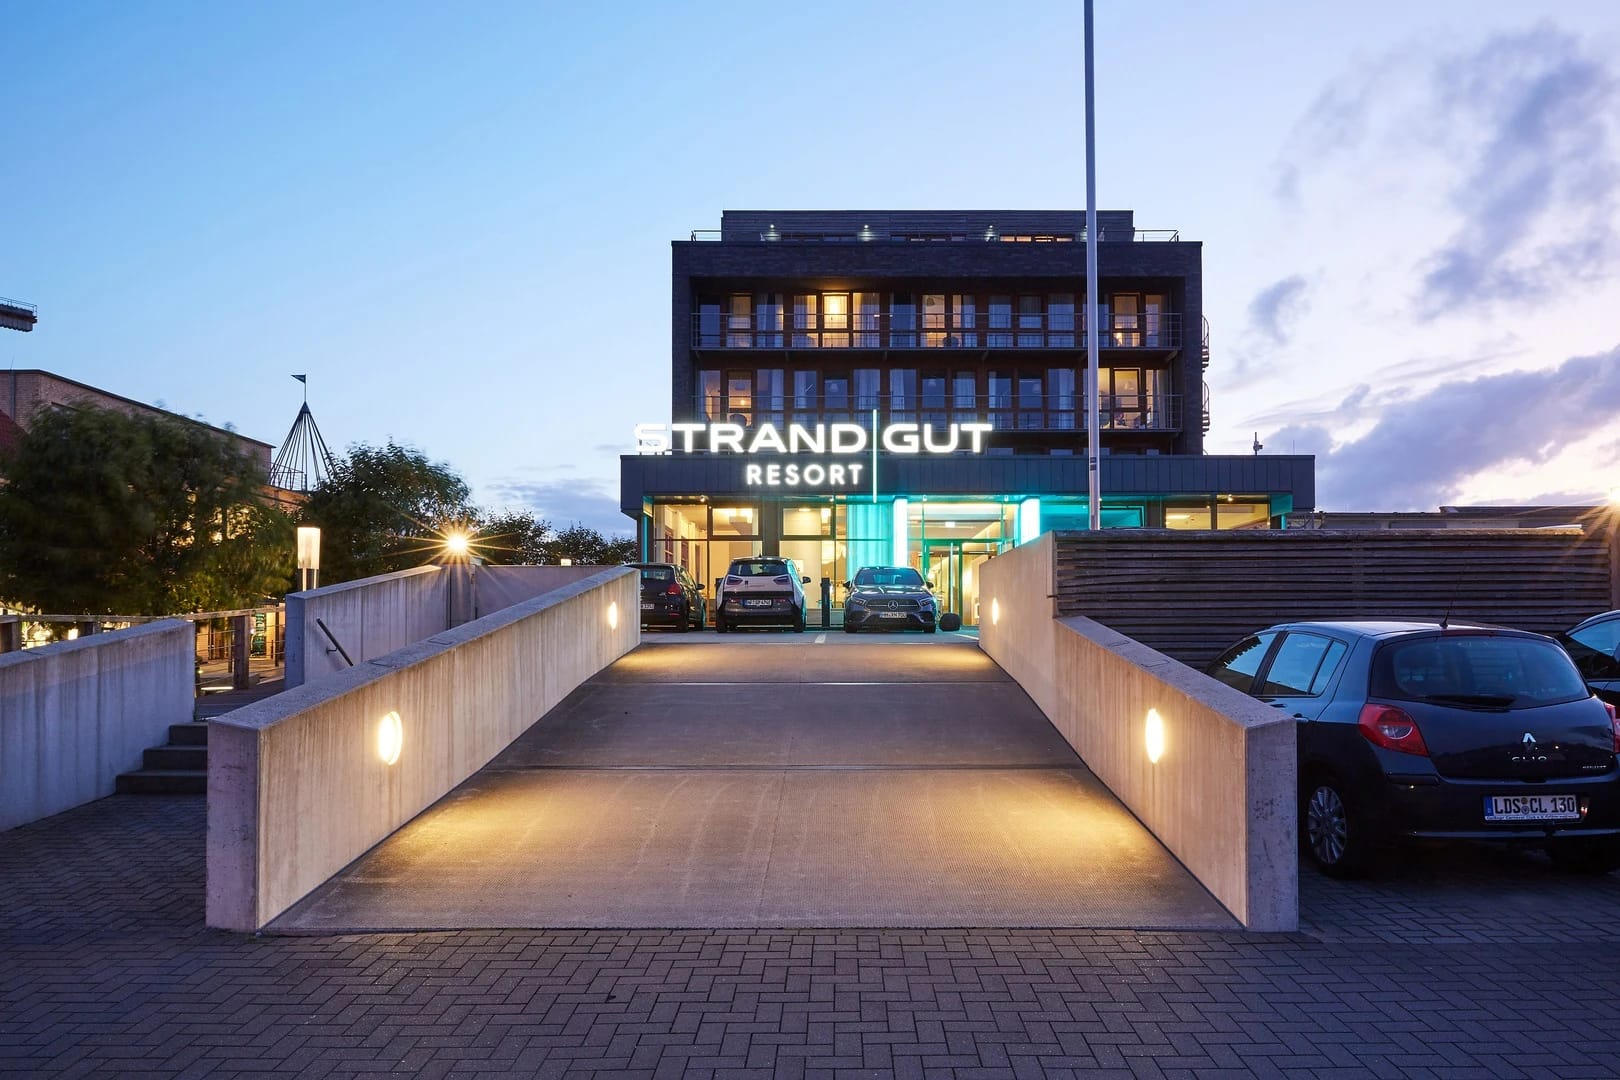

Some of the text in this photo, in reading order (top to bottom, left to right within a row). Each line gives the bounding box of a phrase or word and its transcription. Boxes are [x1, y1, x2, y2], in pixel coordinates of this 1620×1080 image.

[634, 423, 993, 453] STRAND GUT
[746, 464, 863, 485] RESORT
[1494, 797, 1575, 814] LDS CL 130
